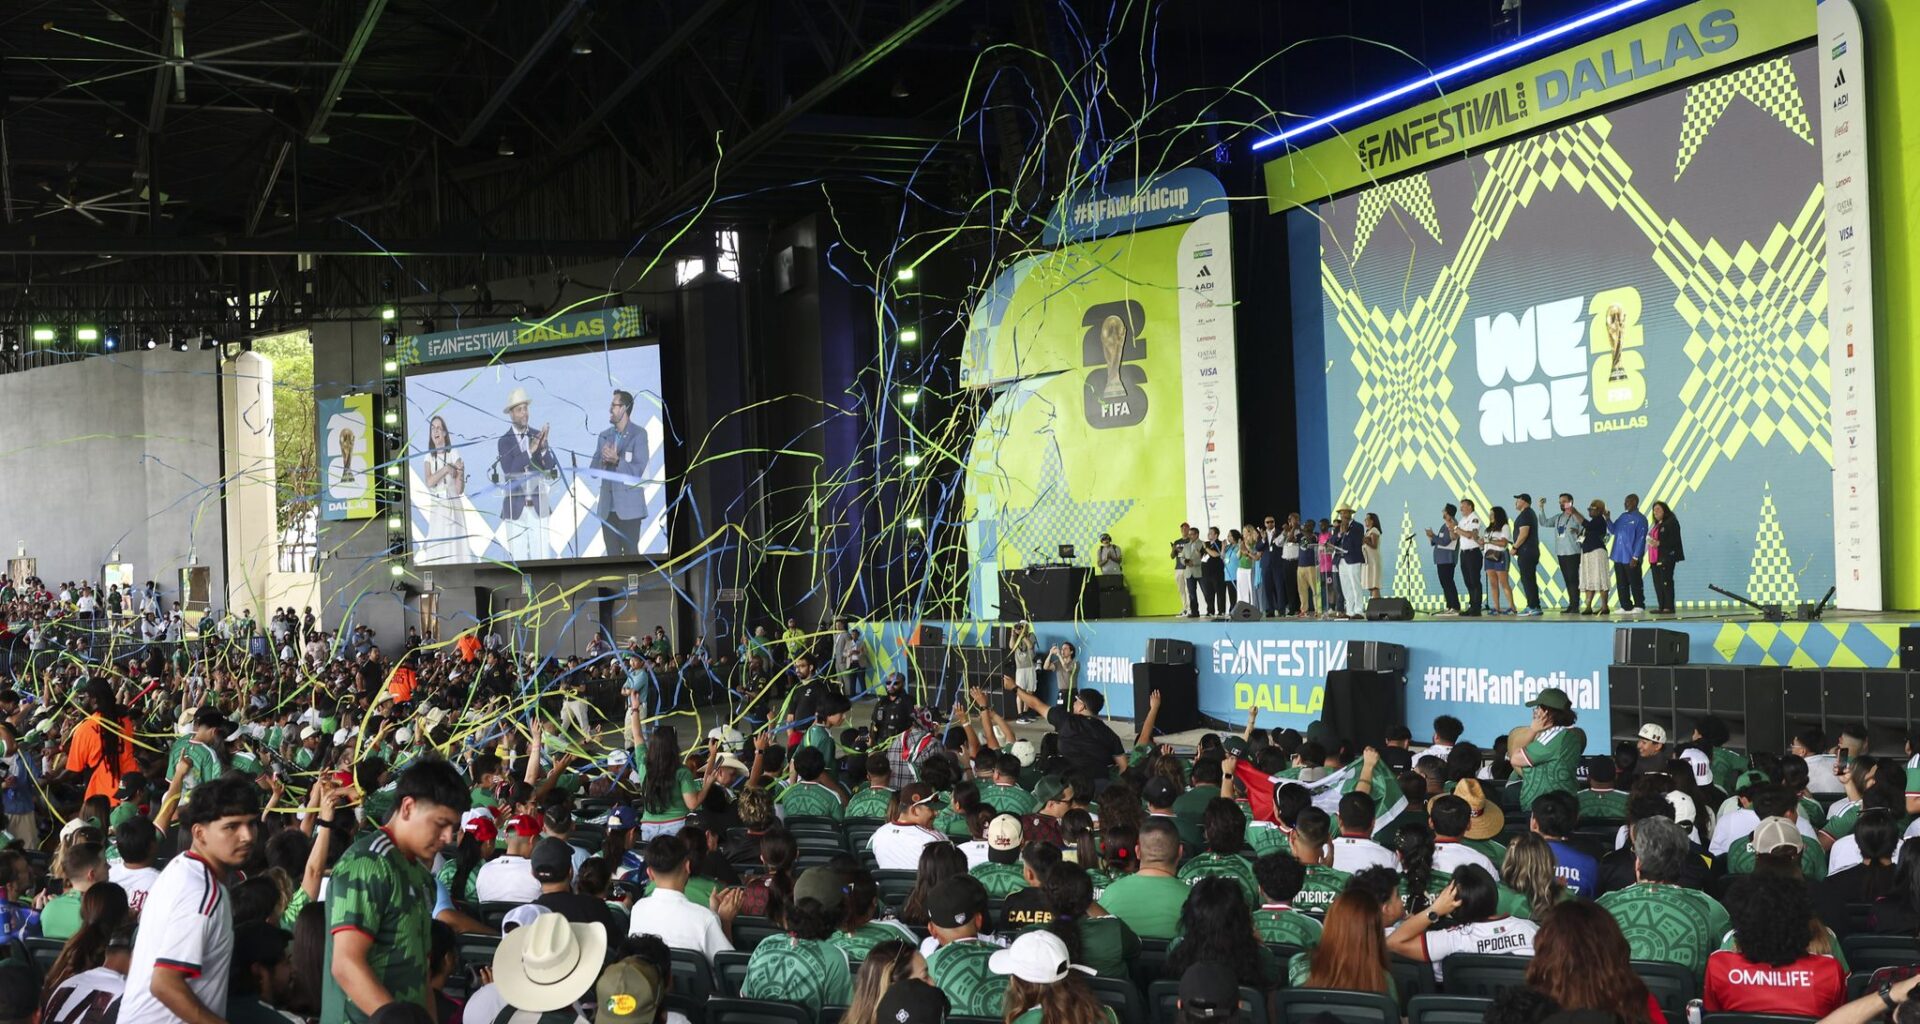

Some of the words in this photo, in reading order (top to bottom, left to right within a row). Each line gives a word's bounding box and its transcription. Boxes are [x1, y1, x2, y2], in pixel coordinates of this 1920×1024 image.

[1517, 81, 1528, 117] 2026
[1536, 8, 1739, 112] DALLAS
[1074, 187, 1189, 225] #FIFAWorldCup
[1839, 226, 1853, 241] VISA
[1200, 282, 1214, 290] ADI
[518, 318, 605, 345] DALLAS
[1197, 335, 1216, 343] Lenovo
[1475, 296, 1588, 387] WE
[1197, 349, 1216, 359] QATAR
[1200, 367, 1217, 377] VISA
[1100, 401, 1131, 418] FIFA
[1594, 415, 1648, 433] DALLAS
[328, 501, 368, 512] DALLAS
[1234, 682, 1325, 715] DALLA
[1292, 890, 1336, 904] IMENEZ
[1728, 968, 1811, 987] OMNILIFE
